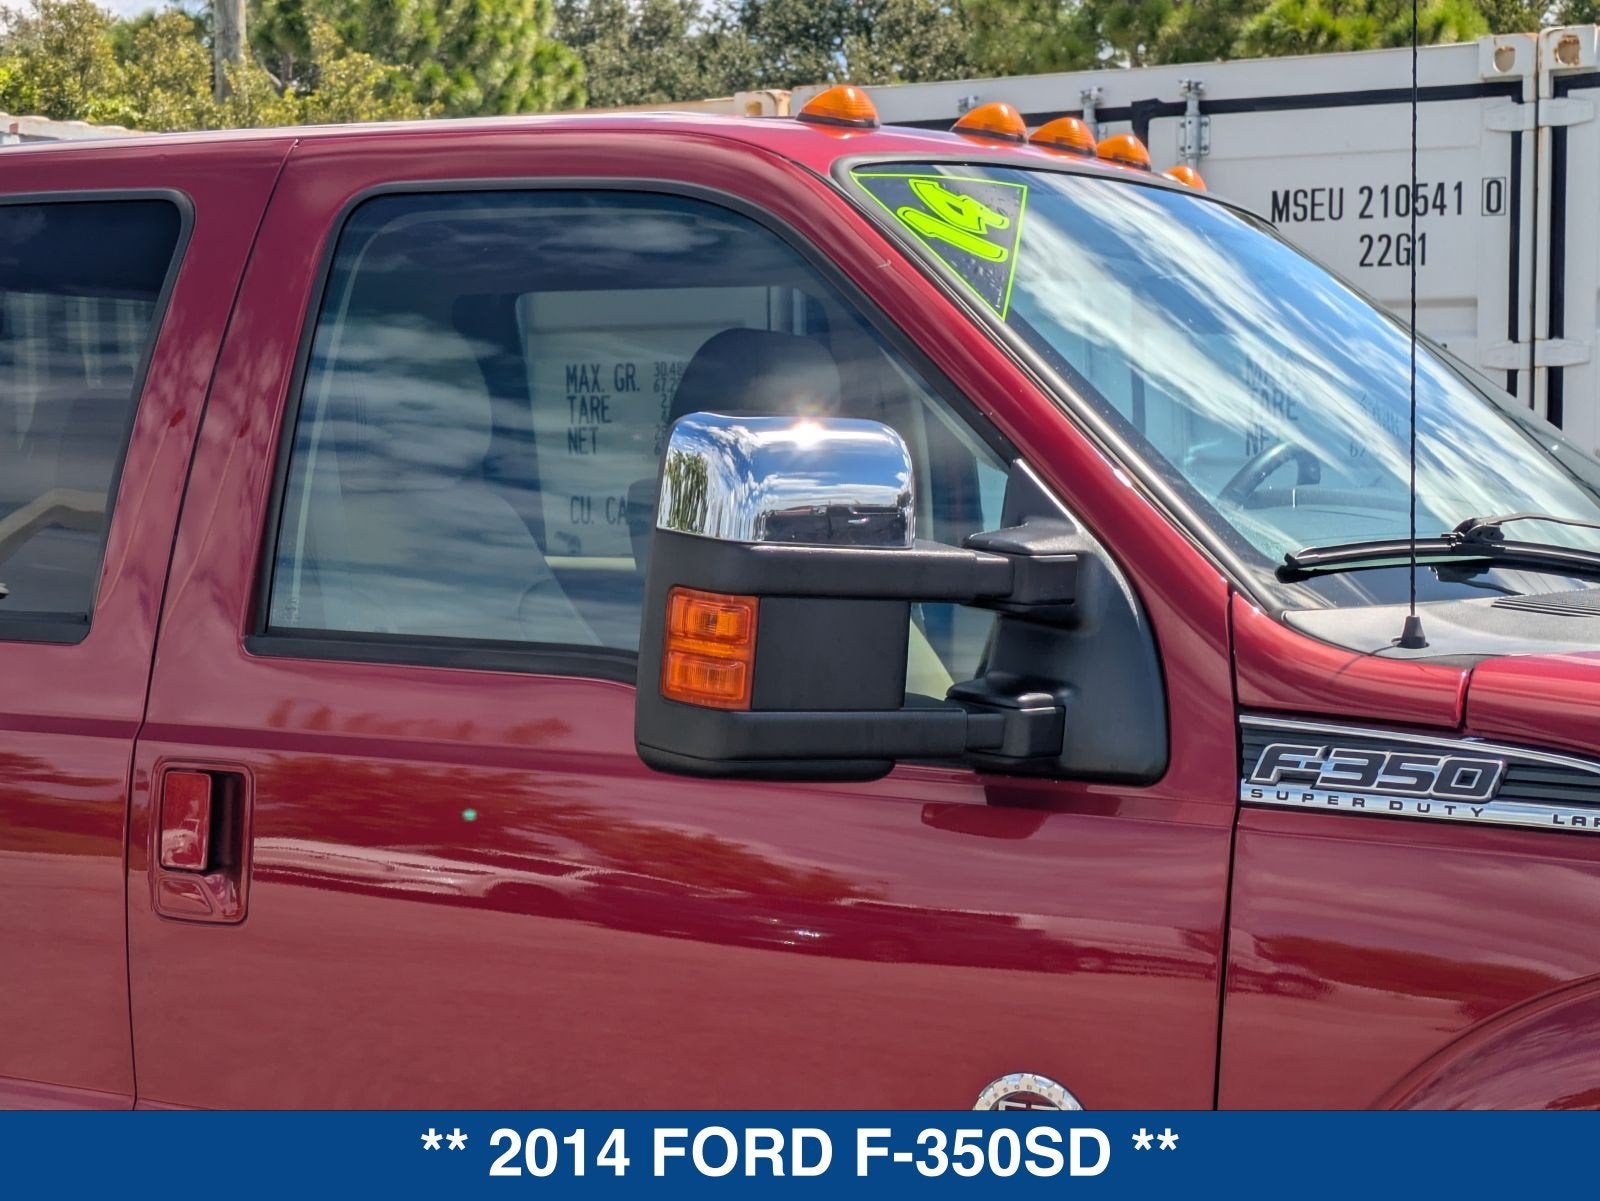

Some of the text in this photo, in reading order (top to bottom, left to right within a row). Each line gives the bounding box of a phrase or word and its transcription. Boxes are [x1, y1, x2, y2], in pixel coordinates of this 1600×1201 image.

[1270, 188, 1345, 224] MSEU
[1358, 181, 1464, 219] 210541
[897, 179, 1010, 263] 14
[1359, 232, 1427, 268] 22G1
[565, 362, 641, 393] MAX. GR.
[566, 395, 612, 424] TARE
[567, 426, 599, 455] NET
[569, 495, 629, 525] CU. CA
[1250, 788, 1366, 809] SUPER
[1388, 800, 1485, 818] DUTY
